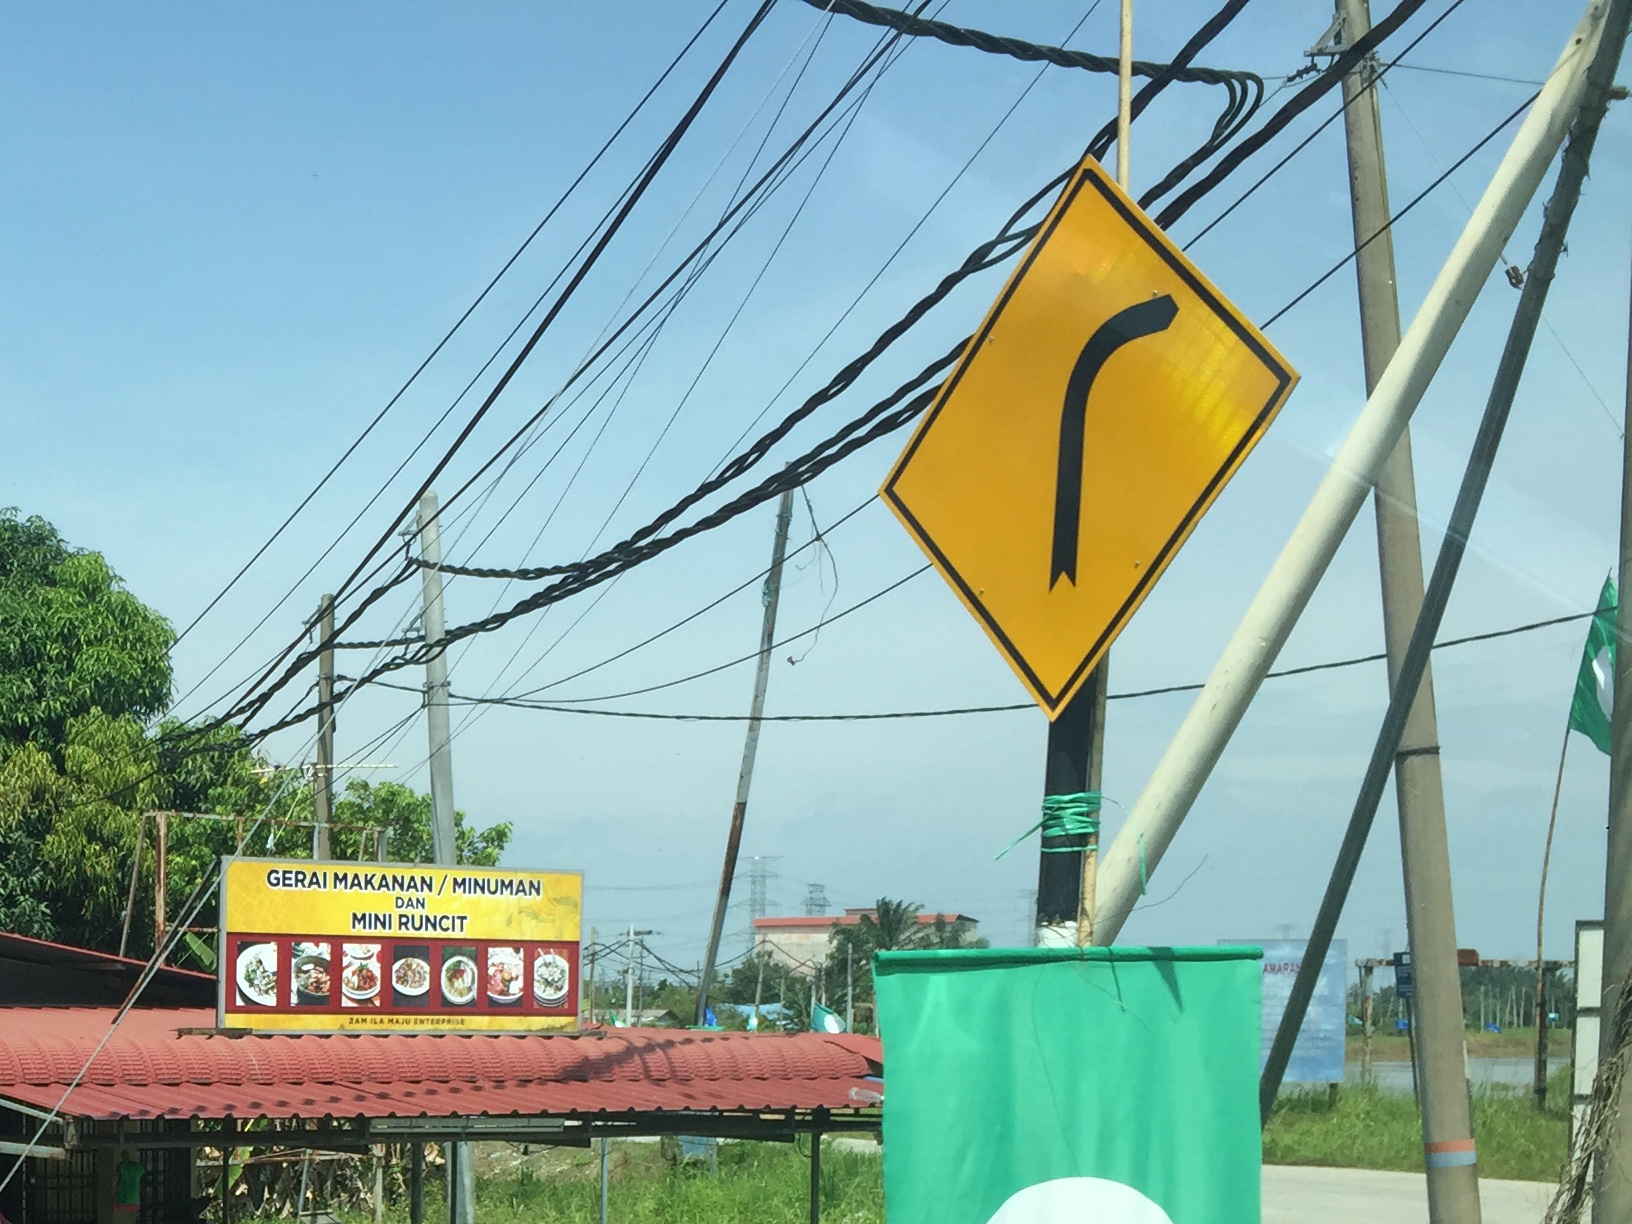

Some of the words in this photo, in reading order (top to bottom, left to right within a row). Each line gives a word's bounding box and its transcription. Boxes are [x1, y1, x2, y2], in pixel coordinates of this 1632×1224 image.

[266, 869, 328, 890] GERAI
[333, 872, 433, 893] MAKANAN
[437, 873, 448, 896] /
[452, 876, 541, 896] MINUMAN
[395, 896, 426, 910] DAN
[352, 912, 392, 931] MINI
[398, 913, 468, 933] RUNCIT
[348, 1017, 368, 1025] ZAM
[388, 1017, 411, 1026] MAJU
[413, 1018, 466, 1026] ENTERPRISE
